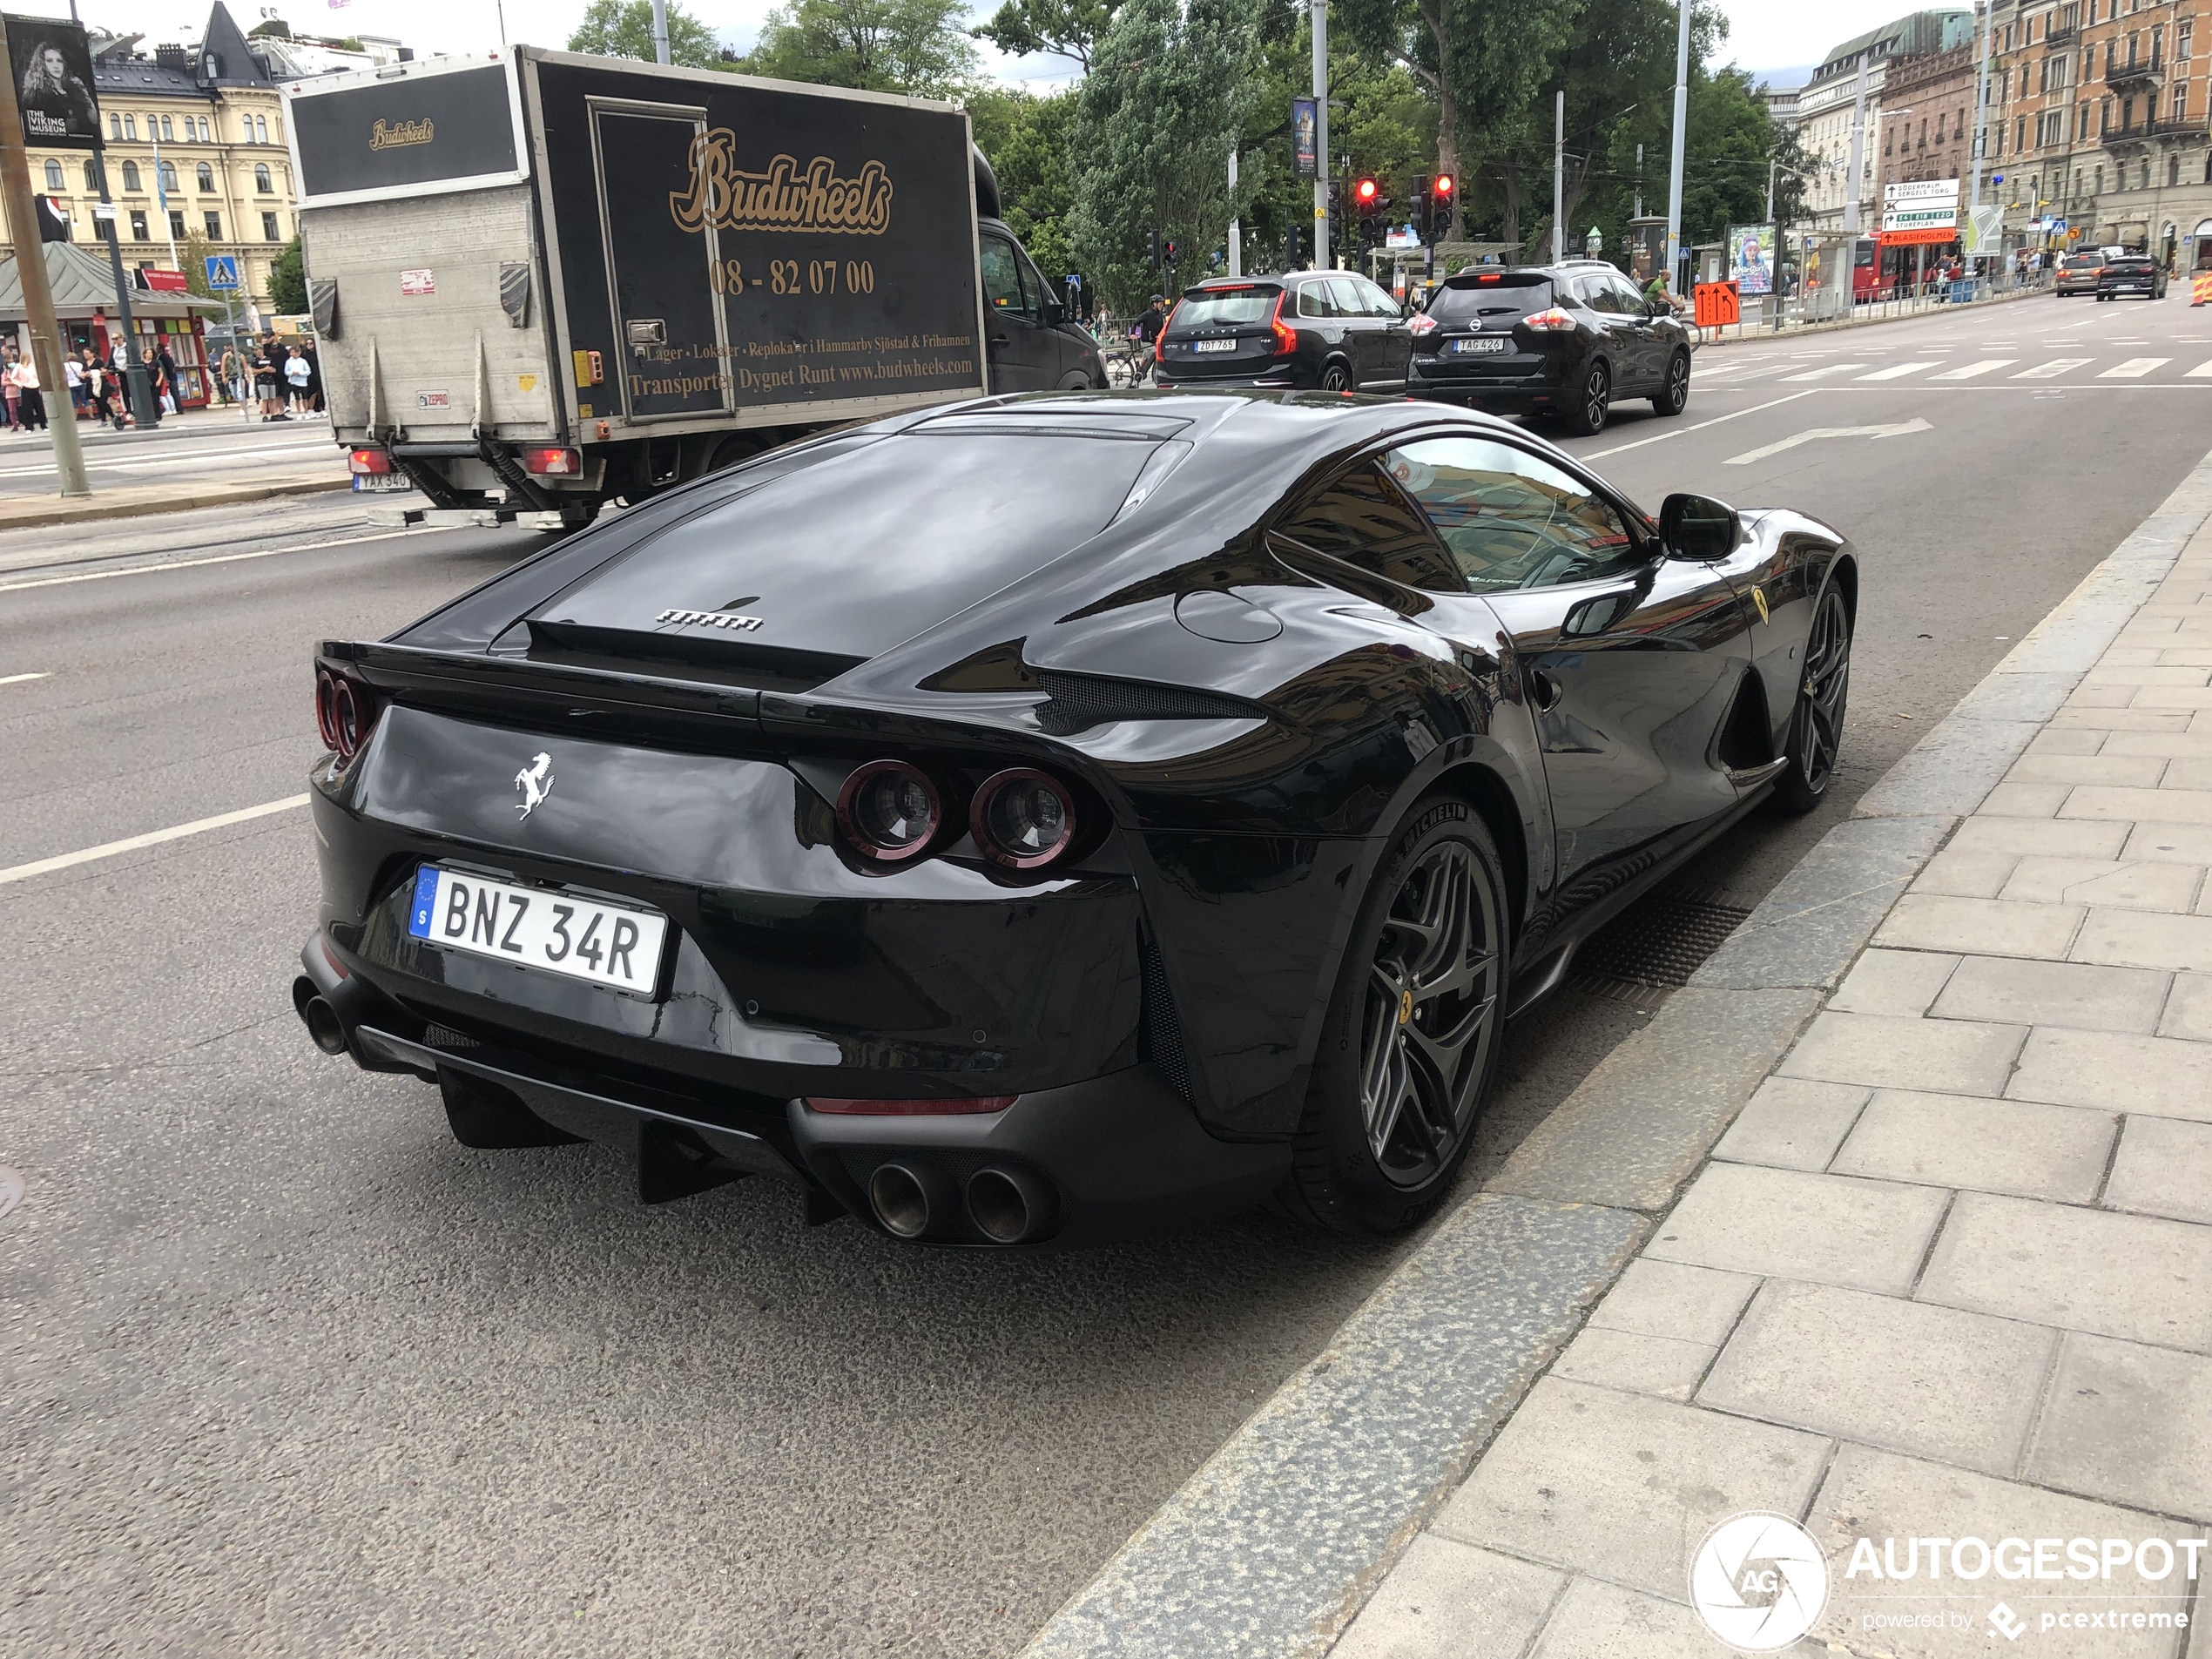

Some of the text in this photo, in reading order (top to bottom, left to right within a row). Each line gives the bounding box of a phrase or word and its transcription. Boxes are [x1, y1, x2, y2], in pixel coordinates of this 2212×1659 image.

[30, 118, 65, 126] VIKING
[30, 125, 66, 133] MUSEUM
[369, 118, 435, 152] Budwheels
[670, 127, 894, 235] Budwheels
[1898, 183, 1940, 192] SÖDERMALM
[1893, 232, 1953, 241] BLASIEHOLMEN
[711, 260, 744, 295] 08
[770, 260, 801, 295] 82
[809, 260, 837, 294] 07
[846, 260, 874, 294] 00
[646, 347, 683, 364] Lager
[692, 344, 739, 359] Lokaler
[816, 337, 872, 354] Hammarby
[874, 335, 909, 354] Sjöstad
[912, 334, 920, 348] &
[922, 334, 971, 347] Frihamnen
[1201, 340, 1233, 350] ZDT 765
[1461, 340, 1500, 349] TAG 426
[630, 357, 973, 399] Transporter Dygnet Runt www.budwheels.com
[363, 474, 407, 488] YAX 340
[655, 609, 764, 631] Ferrari
[1403, 802, 1466, 851] MICHELIN
[418, 910, 427, 925] S
[444, 881, 639, 980] BNZ 34R
